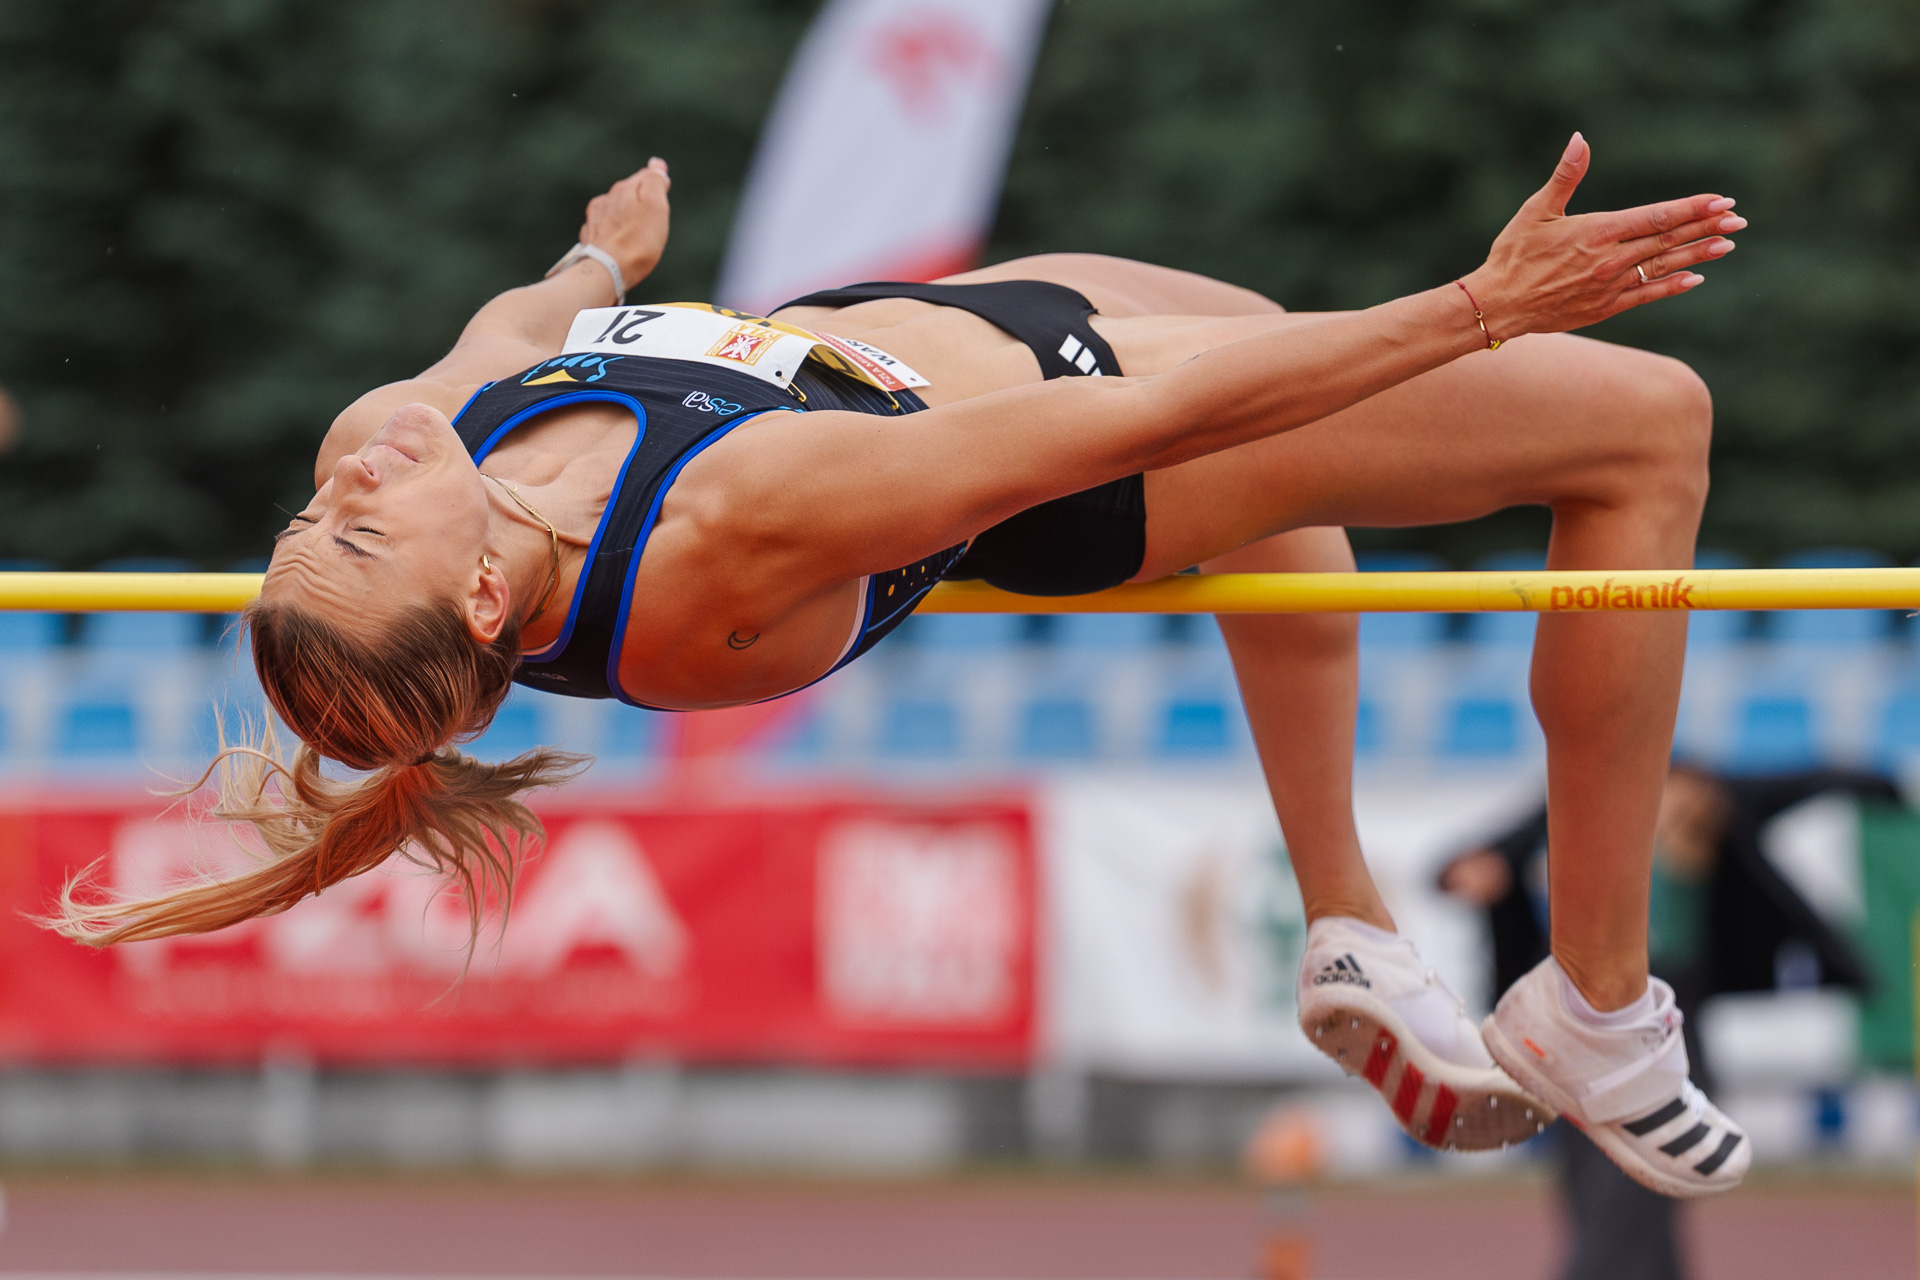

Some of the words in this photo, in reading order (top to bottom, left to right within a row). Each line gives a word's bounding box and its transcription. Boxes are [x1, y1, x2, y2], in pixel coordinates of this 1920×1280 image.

[589, 310, 666, 345] 21
[842, 338, 897, 365] WAR
[520, 352, 625, 383] Sopot
[1550, 577, 1695, 610] polanik
[1313, 971, 1371, 989] adidas
